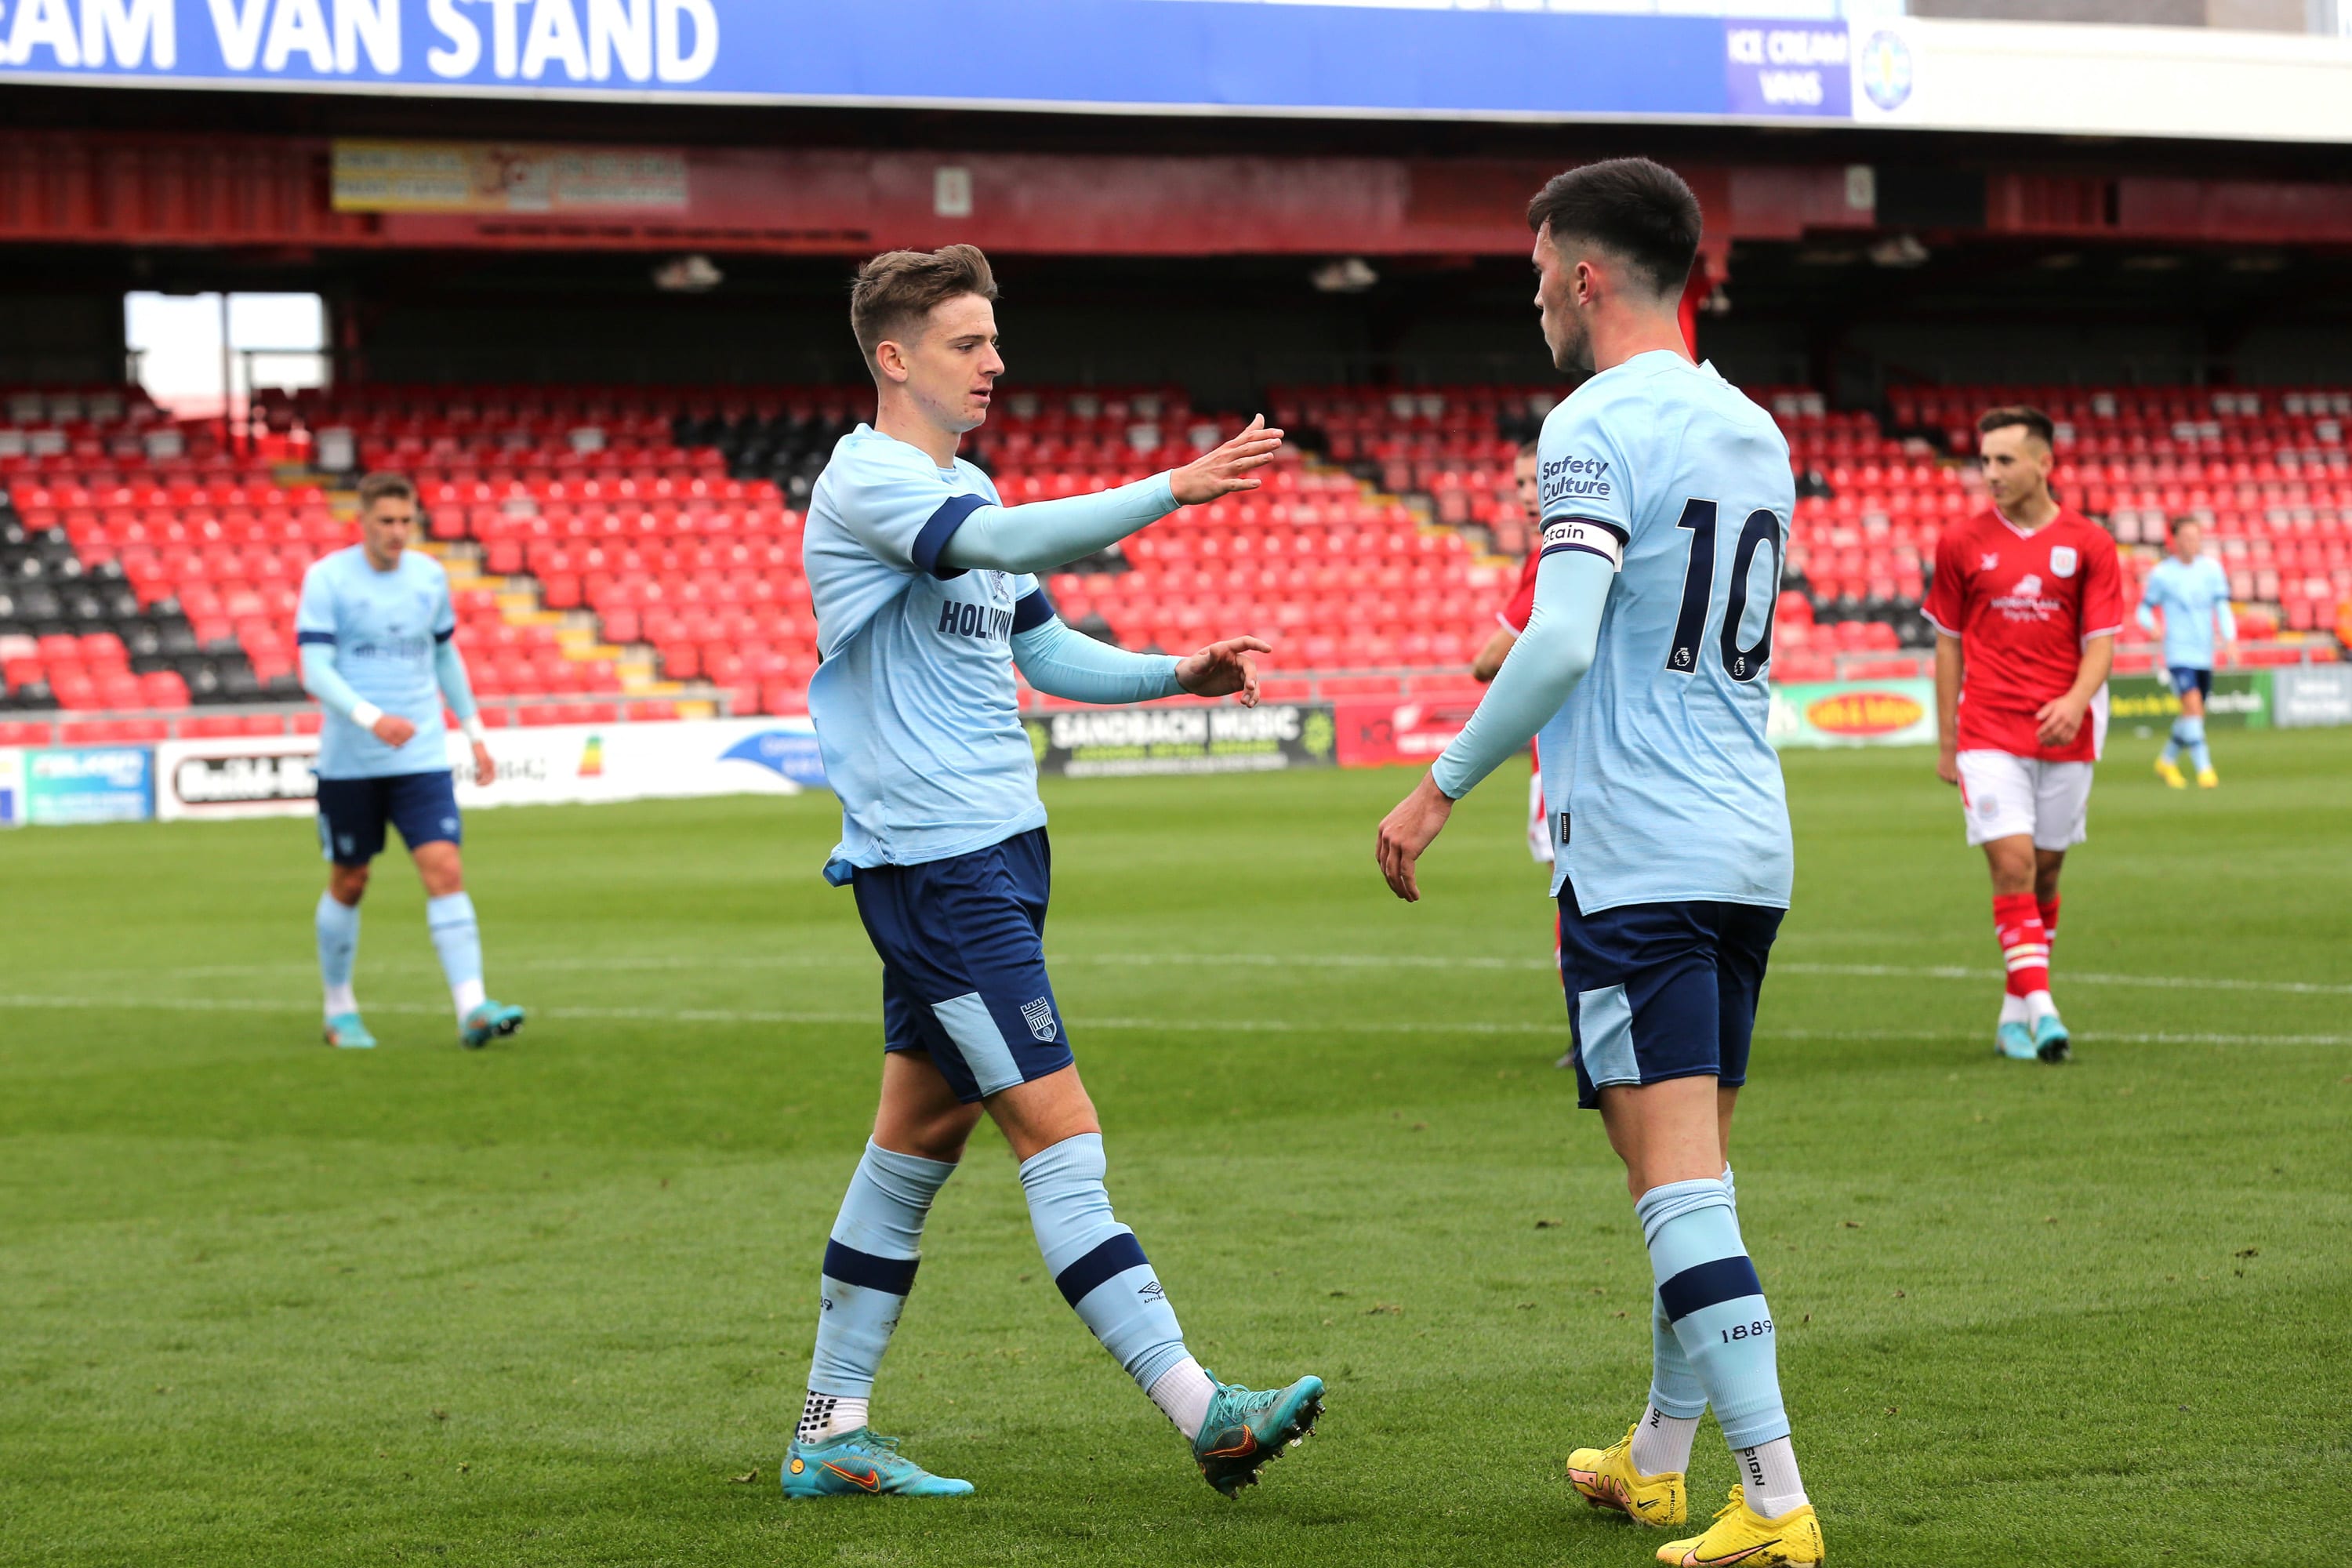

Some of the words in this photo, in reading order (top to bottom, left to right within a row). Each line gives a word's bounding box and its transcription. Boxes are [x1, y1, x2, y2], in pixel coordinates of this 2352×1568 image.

[0, 0, 176, 69] AM
[207, 0, 401, 74] VAN
[426, 0, 720, 82] STAND
[1543, 456, 1610, 480] Safety
[1543, 476, 1611, 501] Culture
[1664, 496, 1781, 682] 10
[1721, 1319, 1773, 1344] 1889
